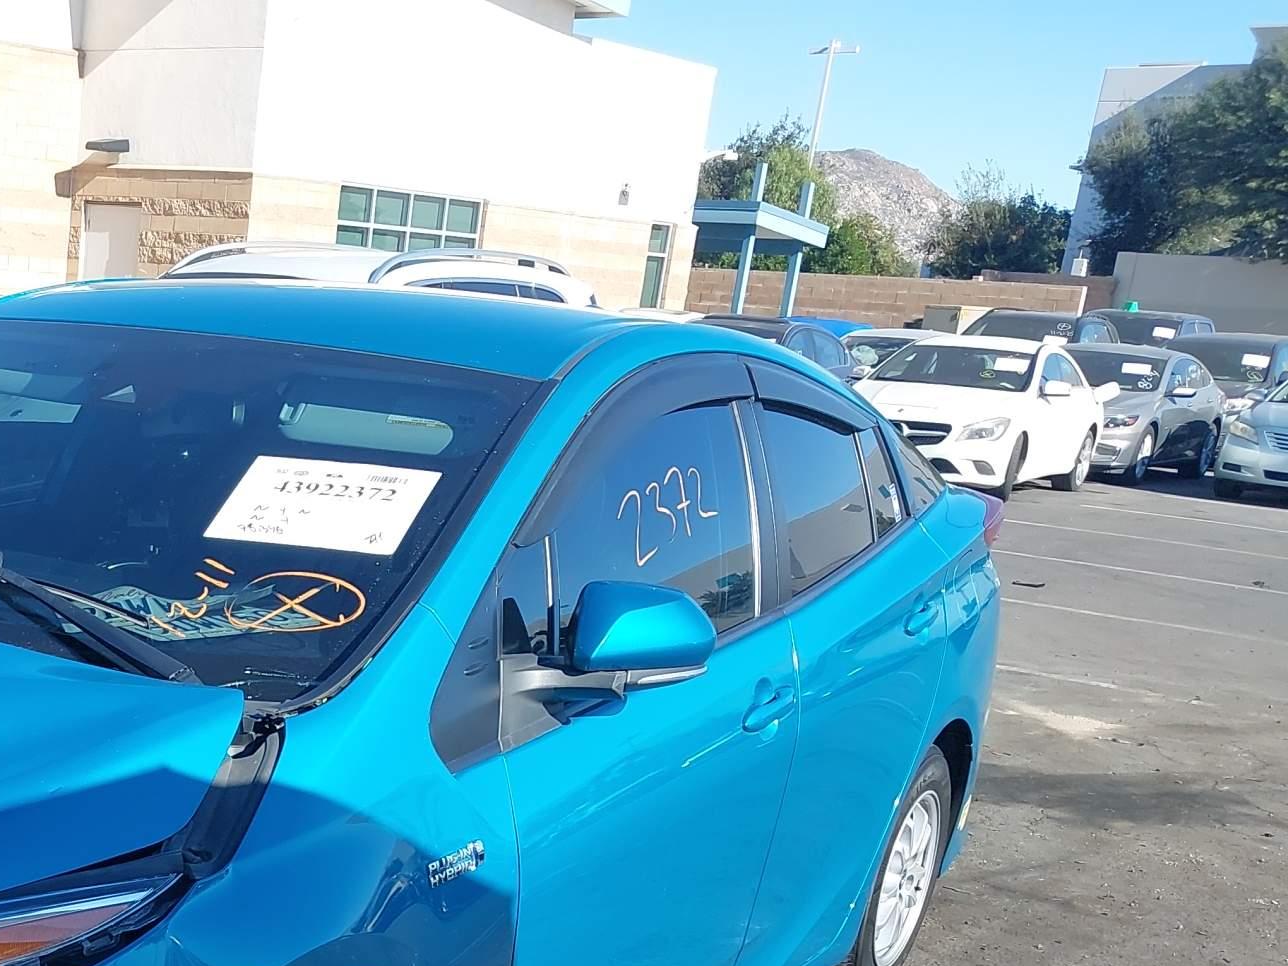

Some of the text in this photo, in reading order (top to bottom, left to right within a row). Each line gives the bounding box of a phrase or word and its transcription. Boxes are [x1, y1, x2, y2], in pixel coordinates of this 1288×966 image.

[274, 480, 397, 502] 43922372
[617, 465, 719, 567] 2372
[430, 859, 476, 888] HYBRID
